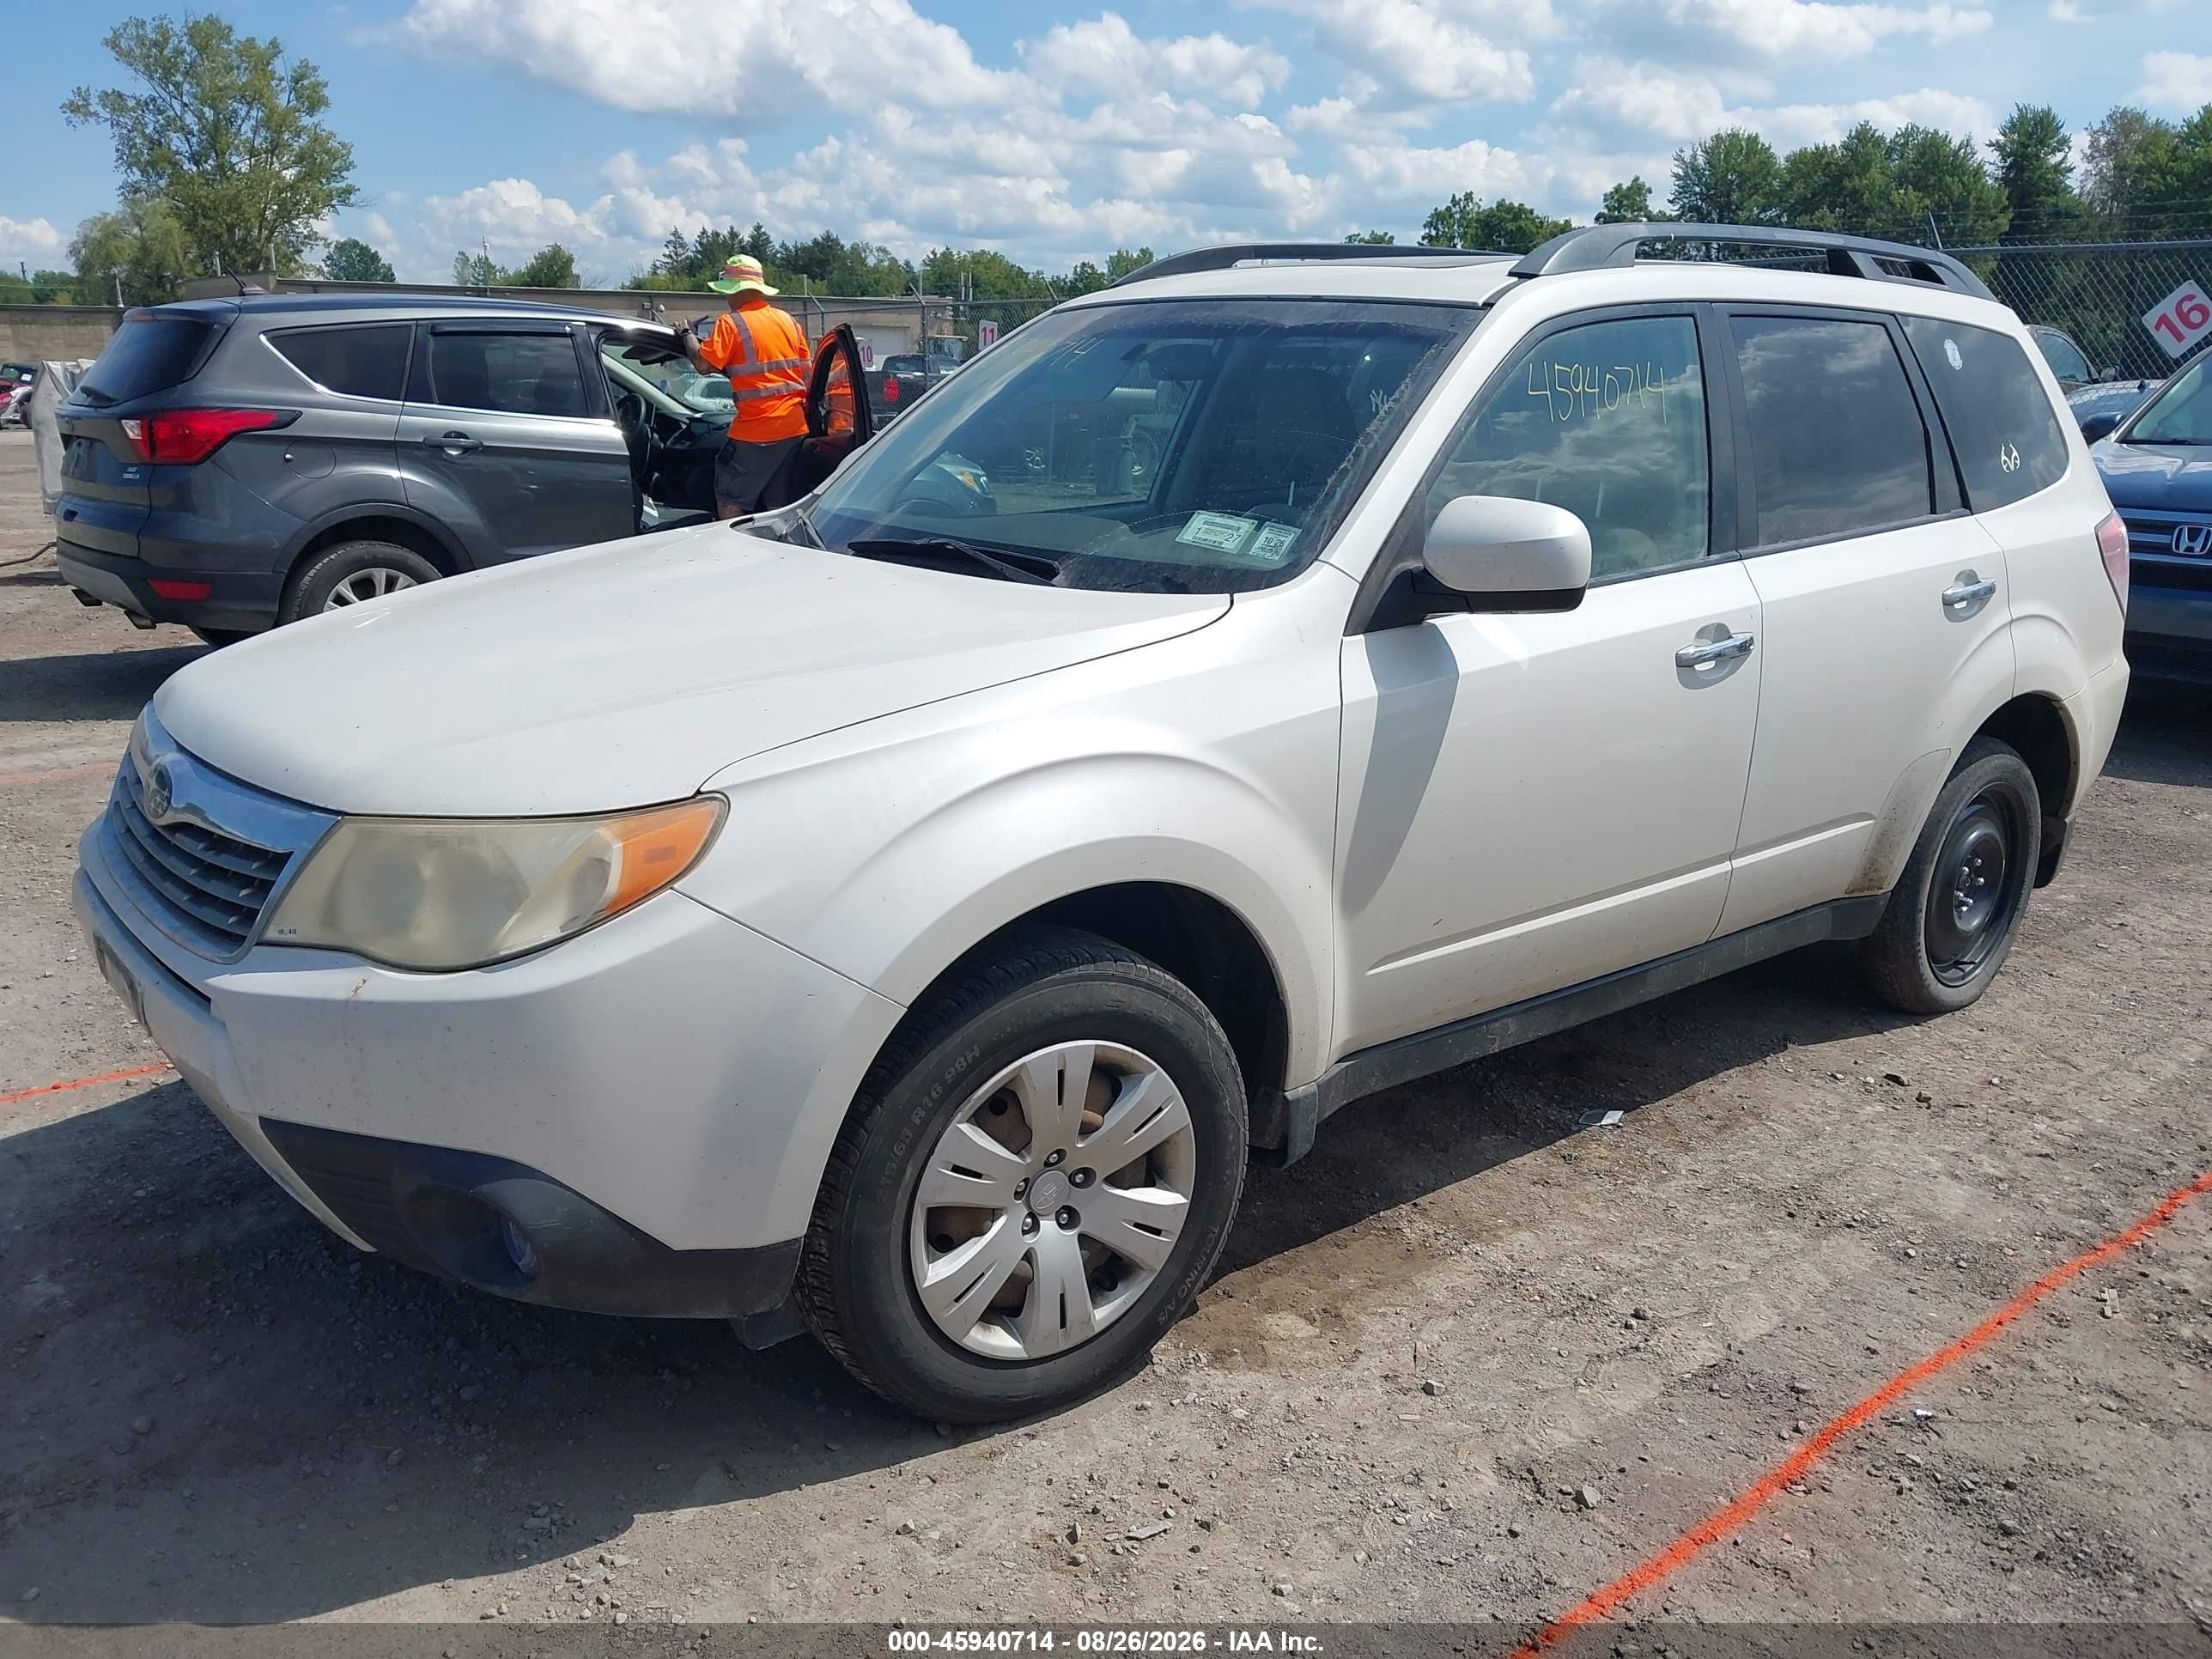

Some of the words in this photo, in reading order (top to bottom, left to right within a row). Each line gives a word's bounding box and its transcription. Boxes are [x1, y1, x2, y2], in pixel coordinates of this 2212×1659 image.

[981, 326, 996, 346] 11
[2154, 294, 2210, 343] 16
[861, 346, 872, 362] 10
[1528, 361, 1668, 424] 45940714
[1224, 532, 1243, 543] 27
[910, 1082, 943, 1126] R16
[945, 1043, 981, 1084] 98H
[1177, 1225, 1219, 1298] TOURING
[1158, 1297, 1176, 1325] A/S
